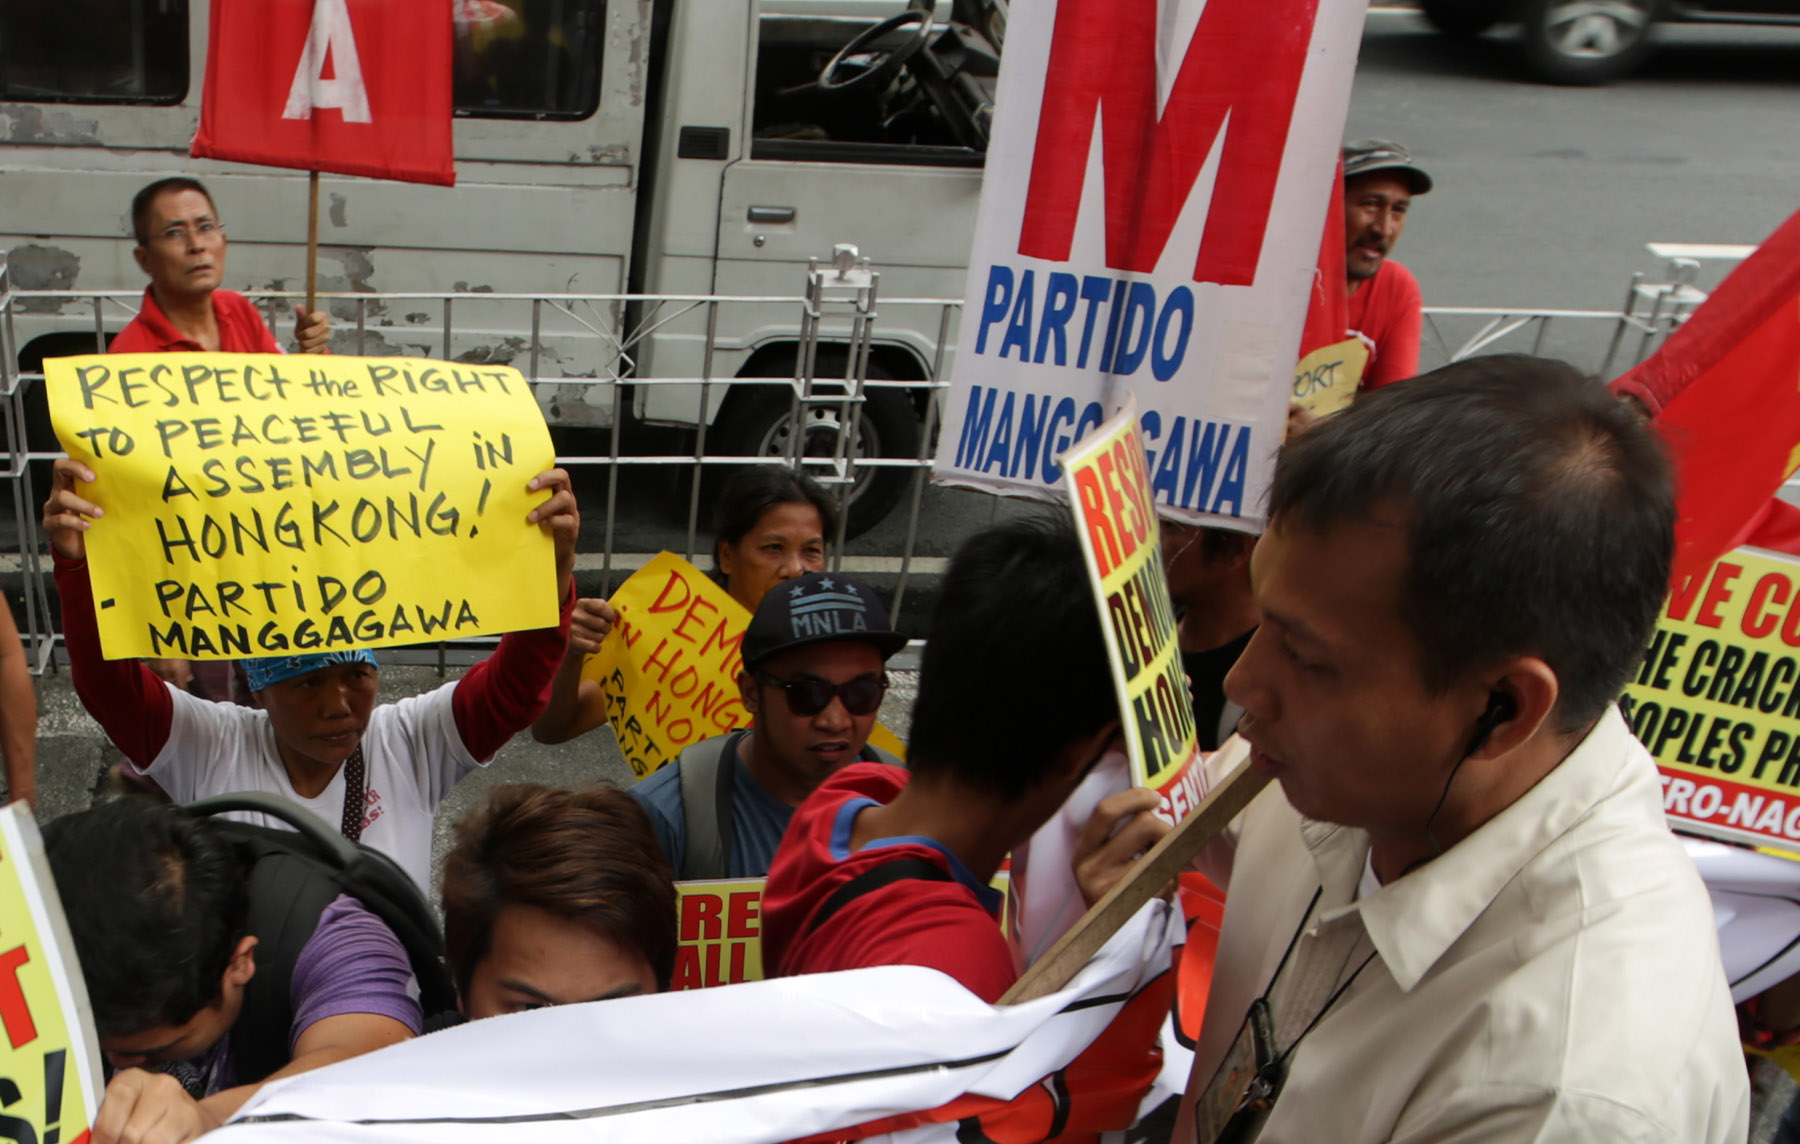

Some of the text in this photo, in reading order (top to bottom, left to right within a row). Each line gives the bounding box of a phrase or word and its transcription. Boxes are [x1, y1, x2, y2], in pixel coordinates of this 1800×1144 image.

[975, 265, 1195, 382] PARTIDO
[302, 369, 362, 398] the
[76, 405, 445, 459] TO PEACEFUL
[161, 437, 436, 504] ASSEMBLY
[155, 478, 492, 566] HONGKONG!
[148, 598, 480, 657] MANGGAGAWA
[790, 609, 867, 639] MNLA
[669, 942, 752, 992] ALL
